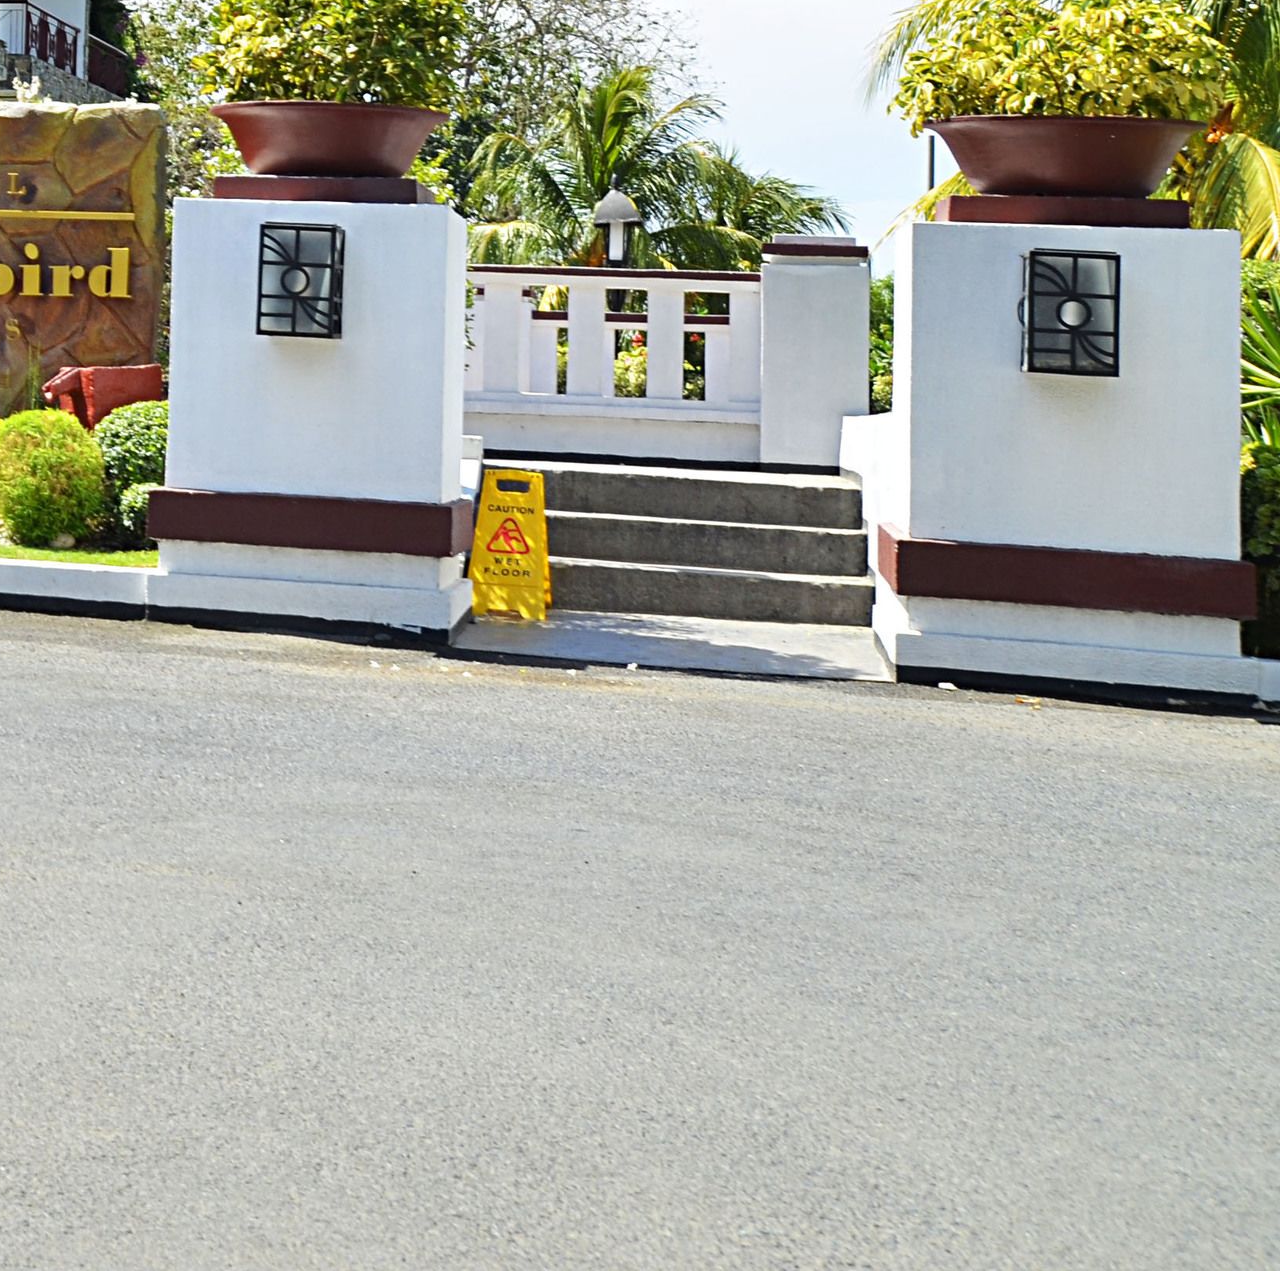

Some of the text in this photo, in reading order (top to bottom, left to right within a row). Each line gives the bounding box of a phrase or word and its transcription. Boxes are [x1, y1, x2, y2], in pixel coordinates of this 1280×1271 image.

[487, 504, 535, 515] CAUTION
[494, 557, 521, 566] WET
[484, 567, 531, 577] FLOOR
